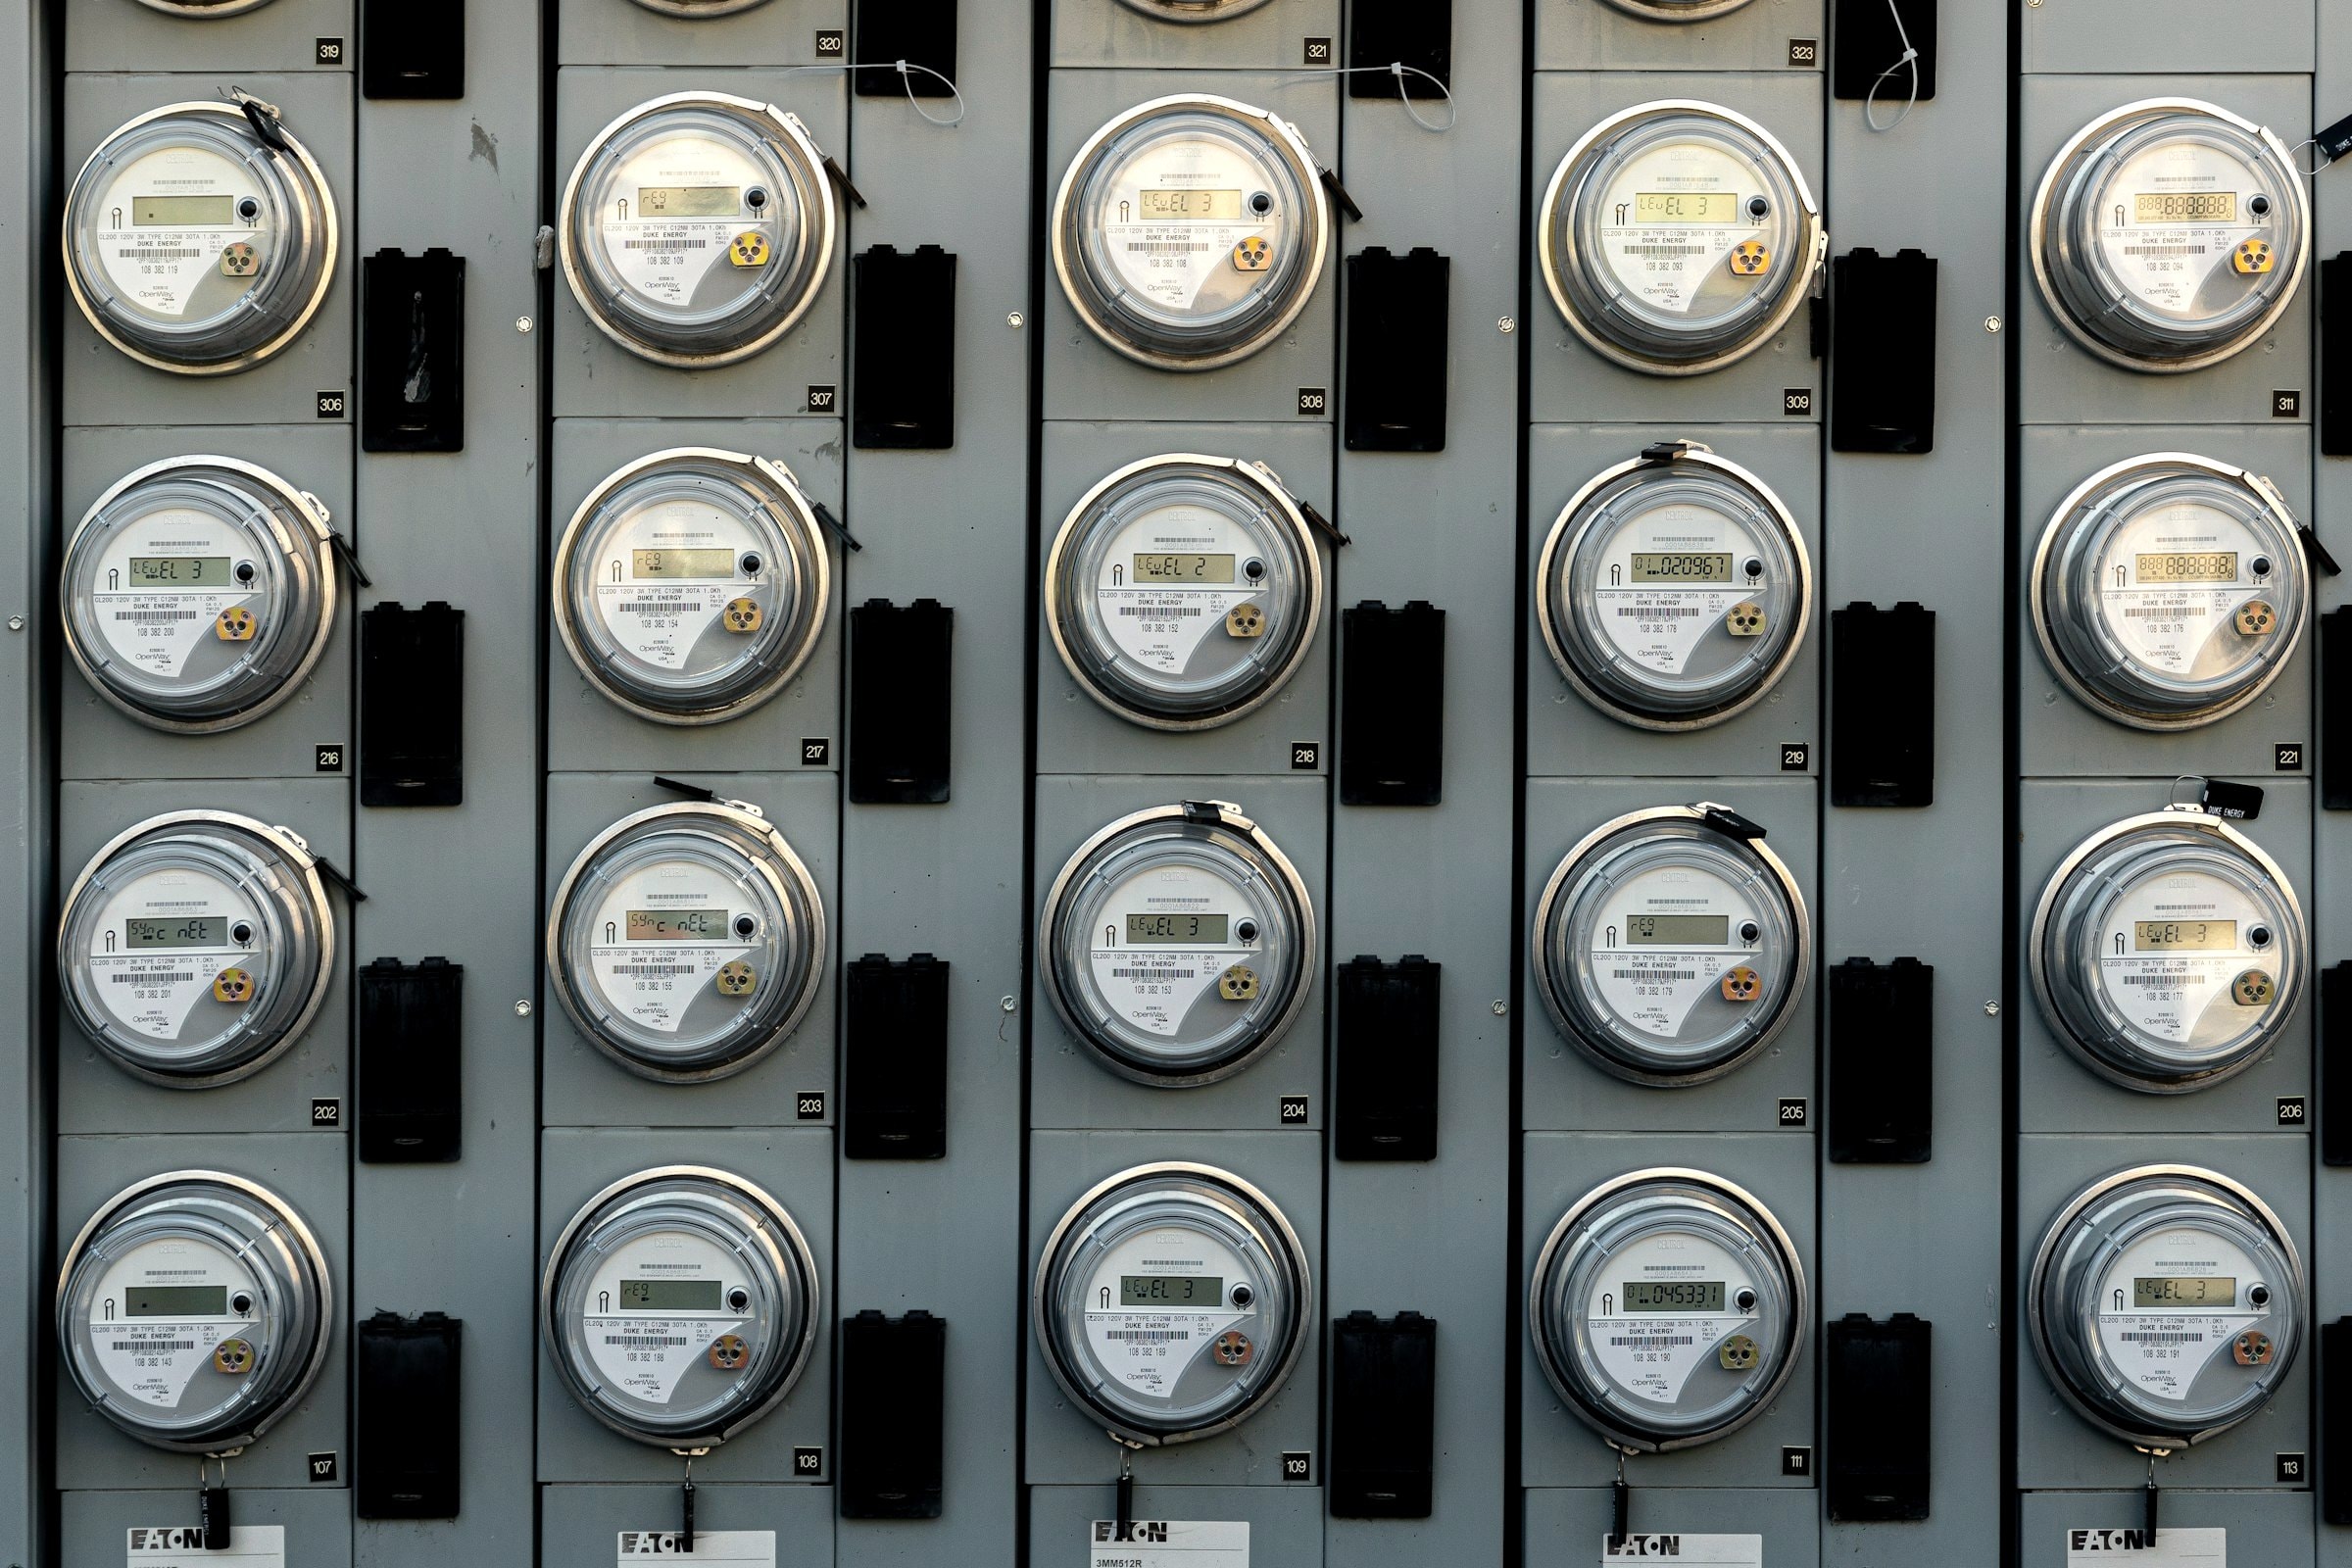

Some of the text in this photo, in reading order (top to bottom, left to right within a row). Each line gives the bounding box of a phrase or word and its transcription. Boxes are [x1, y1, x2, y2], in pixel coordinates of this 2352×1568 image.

[819, 37, 841, 51] 320
[1307, 45, 1327, 57] 321
[319, 45, 339, 59] 319
[1791, 45, 1813, 59] 323
[1201, 194, 1211, 212] 3
[1697, 197, 1707, 216] 3
[647, 256, 657, 266] 108
[660, 256, 669, 266] 382
[141, 265, 151, 274] 108
[154, 265, 164, 274] 382
[319, 398, 343, 412] 306
[809, 392, 833, 406] 307
[1301, 394, 1323, 408] 308
[1786, 396, 1809, 408] 309
[2279, 398, 2293, 410] 311
[191, 562, 202, 579] 3
[1196, 558, 1205, 575] 2
[1660, 557, 1724, 574] 020967
[641, 619, 652, 628] 108
[654, 619, 664, 628] 382
[1142, 623, 1152, 633] 108
[1154, 623, 1164, 633] 382
[1640, 624, 1650, 633] 108
[1652, 624, 1663, 633] 382
[2146, 624, 2157, 633] 108
[2159, 624, 2170, 633] 382
[137, 627, 147, 636] 108
[150, 627, 160, 636] 382
[319, 751, 339, 764] 216
[806, 745, 823, 759] 217
[1296, 749, 1315, 762] 218
[1786, 751, 1803, 764] 219
[2279, 751, 2297, 764] 221
[2207, 806, 2245, 818] DUKE ENERGY
[1188, 918, 1199, 936] 3
[2196, 924, 2207, 943] 3
[635, 981, 645, 991] 108
[648, 981, 658, 991] 382
[1636, 987, 1645, 996] 108
[1648, 987, 1658, 996] 382
[134, 990, 144, 999] 108
[147, 990, 157, 999] 382
[2146, 992, 2156, 1001] 108
[2158, 992, 2169, 1001] 382
[314, 1105, 337, 1119] 202
[800, 1100, 821, 1113] 203
[1284, 1103, 1305, 1117] 204
[1782, 1105, 1803, 1119] 205
[2279, 1105, 2303, 1117] 206
[1182, 1280, 1193, 1298] 3
[1653, 1286, 1716, 1303] 045331
[2195, 1282, 2206, 1300] 3
[1633, 1352, 1643, 1362] 108
[1646, 1352, 1656, 1362] 382
[2143, 1348, 2153, 1358] 108
[2156, 1348, 2166, 1358] 382
[134, 1357, 145, 1366] 108
[147, 1357, 158, 1366] 382
[314, 1460, 331, 1474] 107
[798, 1454, 817, 1468] 108
[1288, 1460, 1305, 1474] 109
[1791, 1454, 1803, 1468] 111
[2283, 1460, 2297, 1474] 113
[131, 1529, 202, 1549] EATON
[2072, 1531, 2143, 1550] EATON
[1096, 1559, 1142, 1568] 3MM512R
